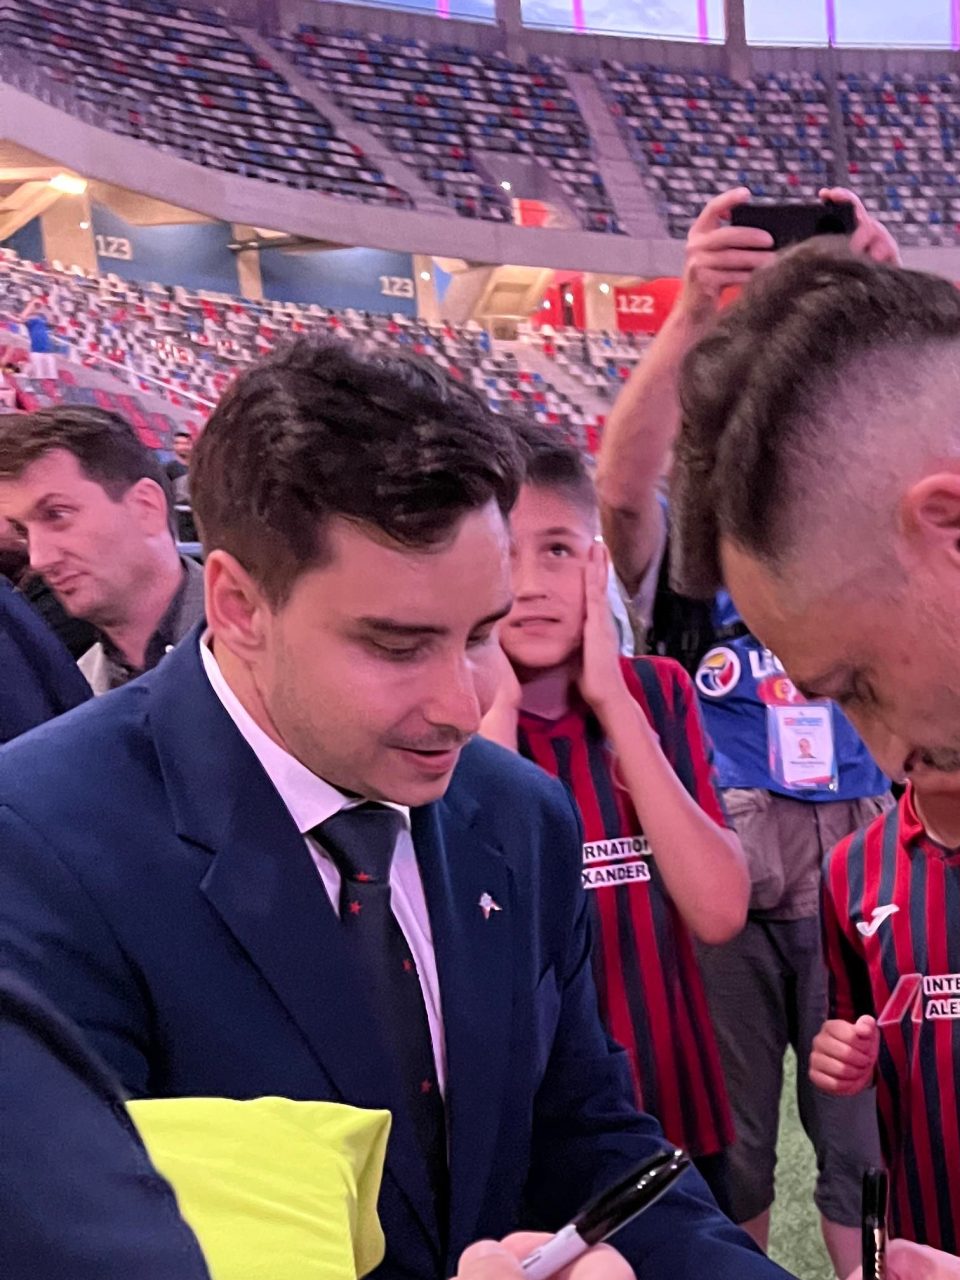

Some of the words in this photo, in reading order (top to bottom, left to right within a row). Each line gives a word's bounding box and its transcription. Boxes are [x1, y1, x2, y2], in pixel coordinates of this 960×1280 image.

[96, 235, 132, 260] 123
[379, 276, 414, 298] 123
[617, 294, 655, 314] 122
